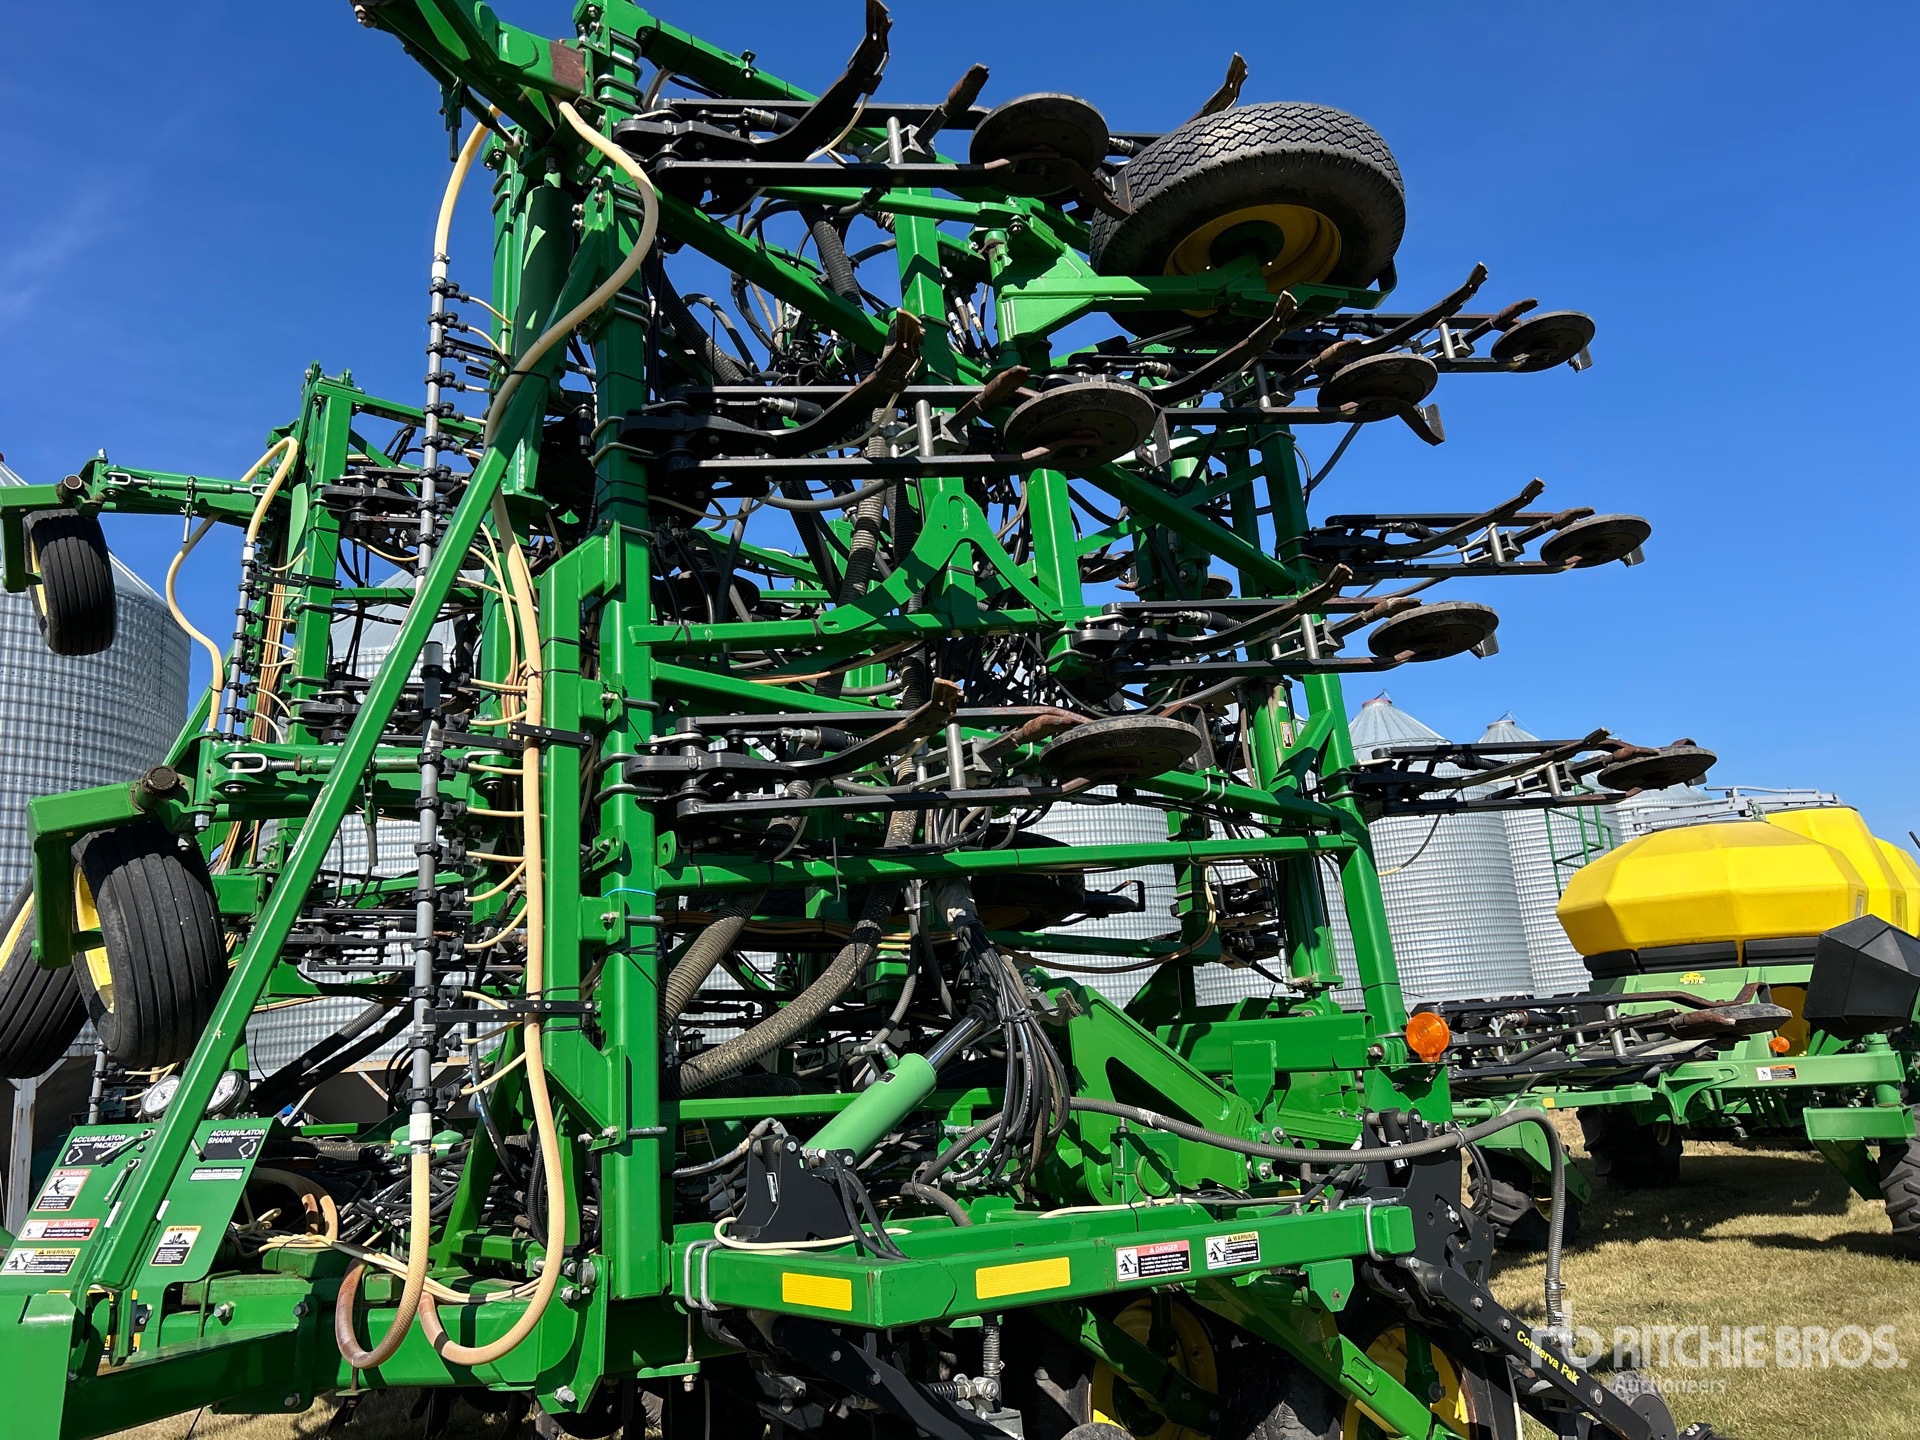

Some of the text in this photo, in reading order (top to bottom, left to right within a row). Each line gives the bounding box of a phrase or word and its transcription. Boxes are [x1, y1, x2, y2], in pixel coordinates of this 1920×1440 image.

[211, 1129, 266, 1137] ACCUMULATOR
[72, 1134, 126, 1143] ACCUMULATOR
[93, 1141, 123, 1149] PACKE
[1233, 1233, 1256, 1241] WARNING
[1155, 1243, 1179, 1253] DANGER
[1517, 1330, 1581, 1386] Conserva Pak
